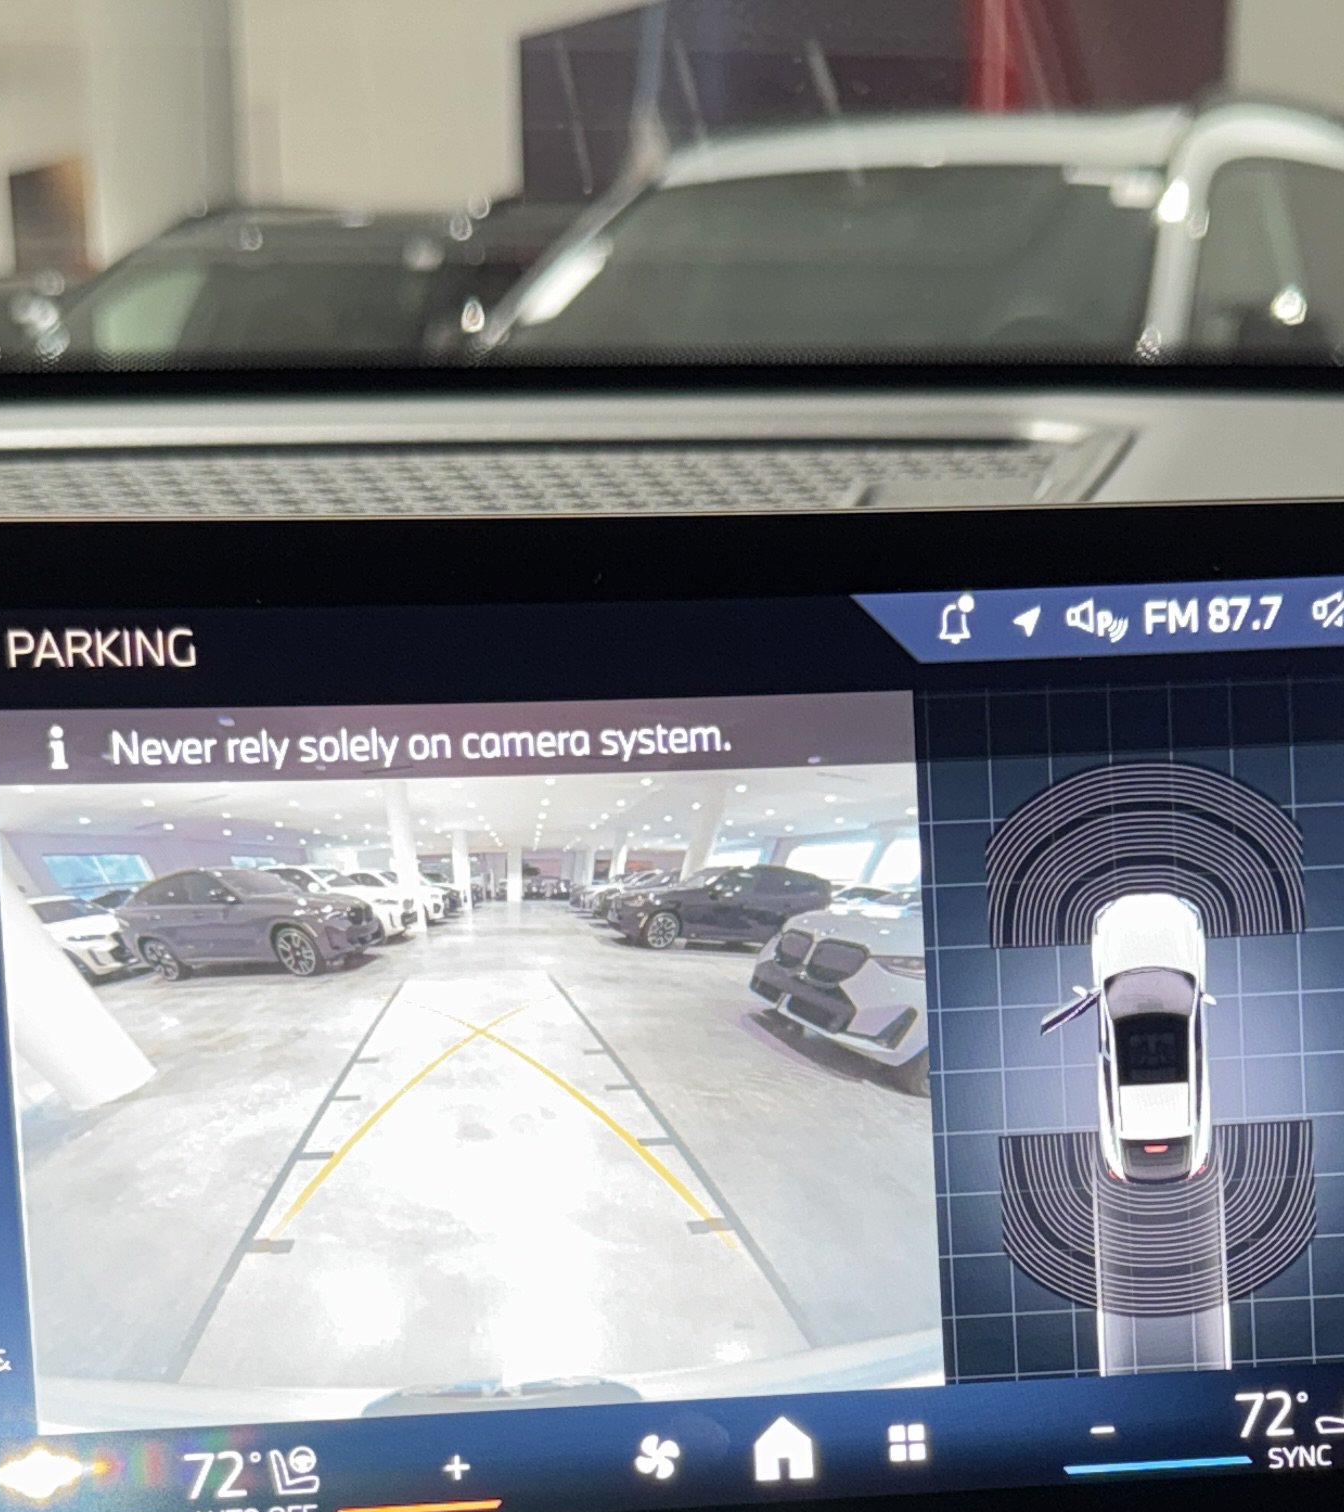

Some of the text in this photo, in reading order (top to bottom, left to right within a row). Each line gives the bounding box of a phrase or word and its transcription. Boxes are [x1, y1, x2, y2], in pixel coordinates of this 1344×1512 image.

[1145, 593, 1283, 634] FM 87.7
[6, 627, 196, 667] PARKING
[111, 724, 732, 770] Never rely solely on camera system.
[1235, 1390, 1308, 1438] 72°
[183, 1450, 262, 1500] 72°
[1267, 1445, 1333, 1470] SYNC
